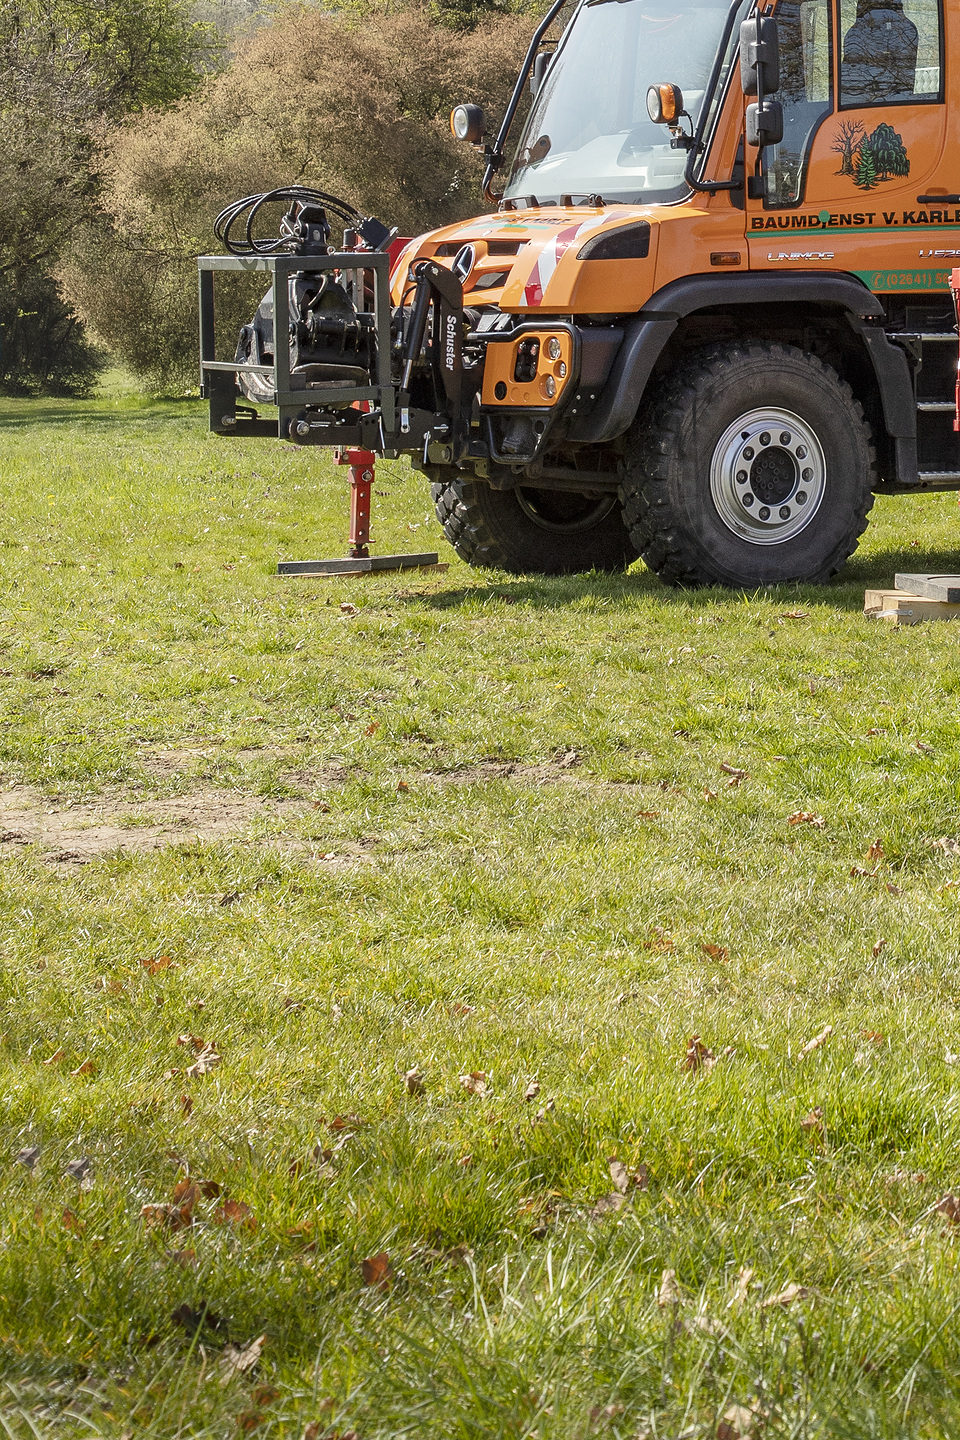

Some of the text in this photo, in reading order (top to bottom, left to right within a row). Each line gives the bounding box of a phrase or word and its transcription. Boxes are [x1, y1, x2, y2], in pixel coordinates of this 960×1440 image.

[751, 210, 877, 230] BAUMDIENST
[882, 211, 899, 225] V.
[766, 251, 835, 262] UNIMOG
[918, 249, 933, 259] U
[886, 272, 932, 288] (02641)
[445, 314, 457, 371] Schuster
